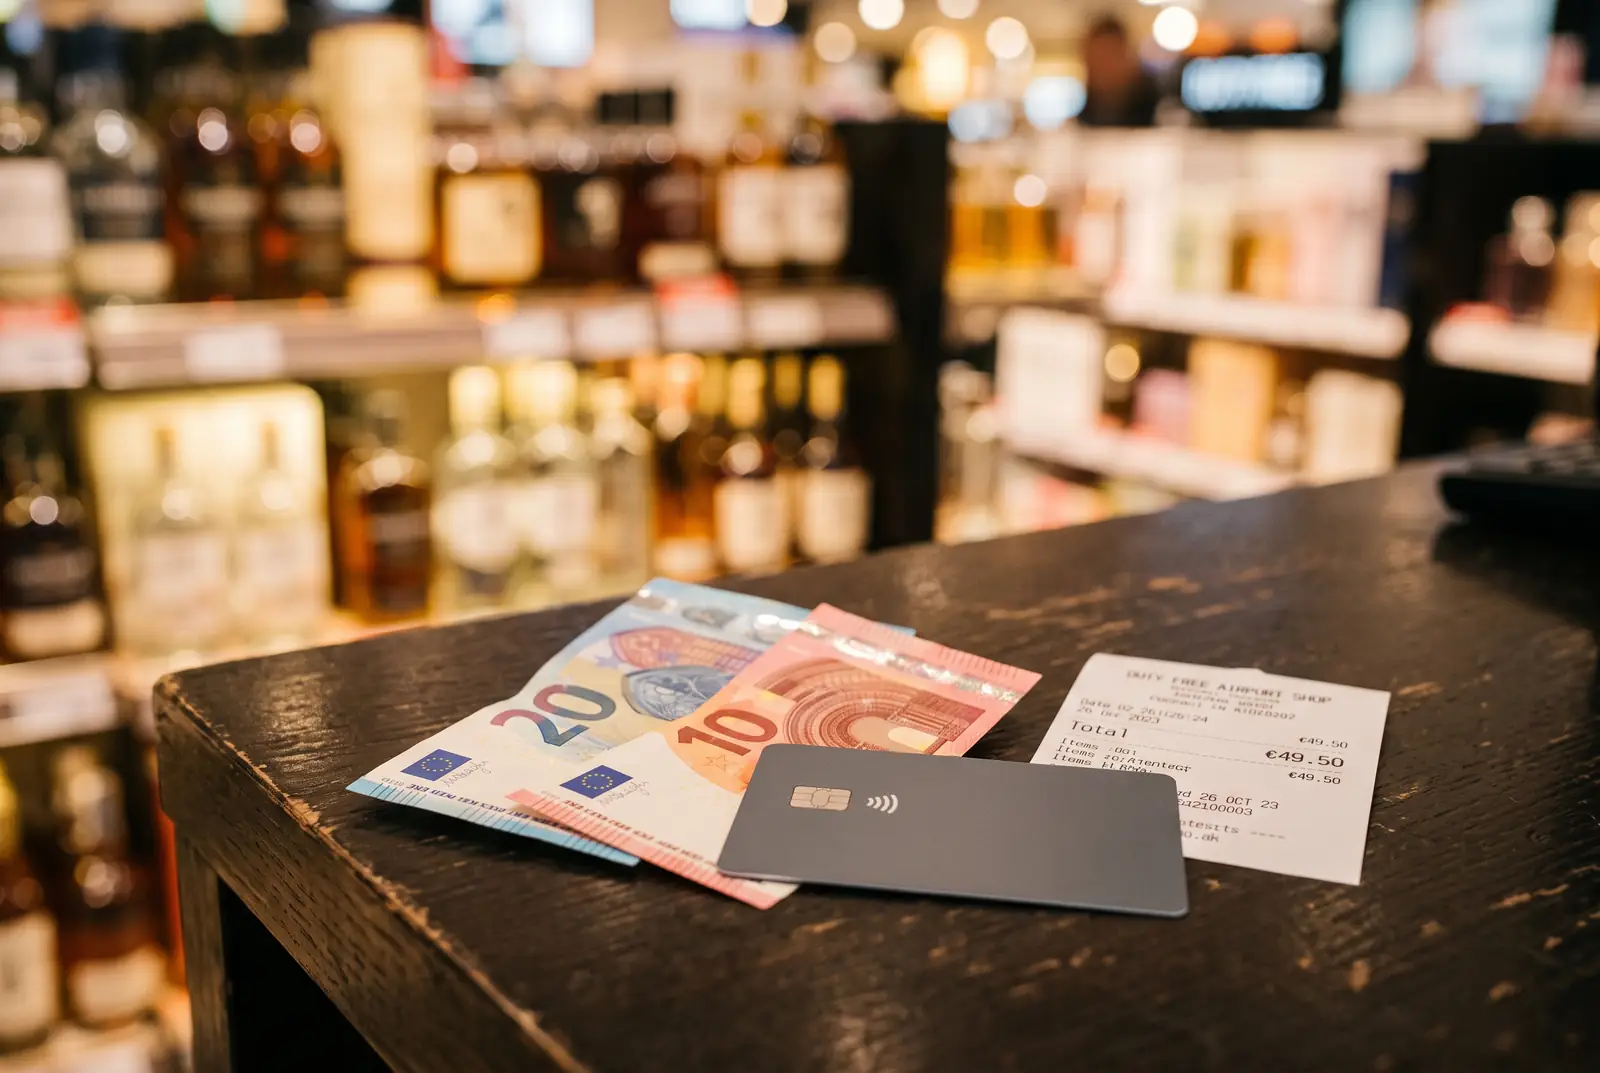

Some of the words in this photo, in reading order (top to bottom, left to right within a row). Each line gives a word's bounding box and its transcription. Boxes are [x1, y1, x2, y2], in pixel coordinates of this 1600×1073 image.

[1171, 676, 1209, 688] FREE
[1217, 683, 1283, 699] AIRPORT
[1292, 692, 1332, 704] SHOP
[490, 684, 616, 747] 20
[1128, 713, 1161, 724] 2023
[678, 708, 778, 757] 10
[1070, 720, 1128, 739] Total
[1299, 736, 1348, 749] €49.50
[1055, 744, 1096, 759] Items
[1060, 737, 1099, 751] Items
[1052, 753, 1092, 766] Items
[1265, 749, 1344, 768] €49.50
[1288, 771, 1341, 785] €49.50
[1199, 792, 1218, 802] 26
[1260, 800, 1279, 810] 23
